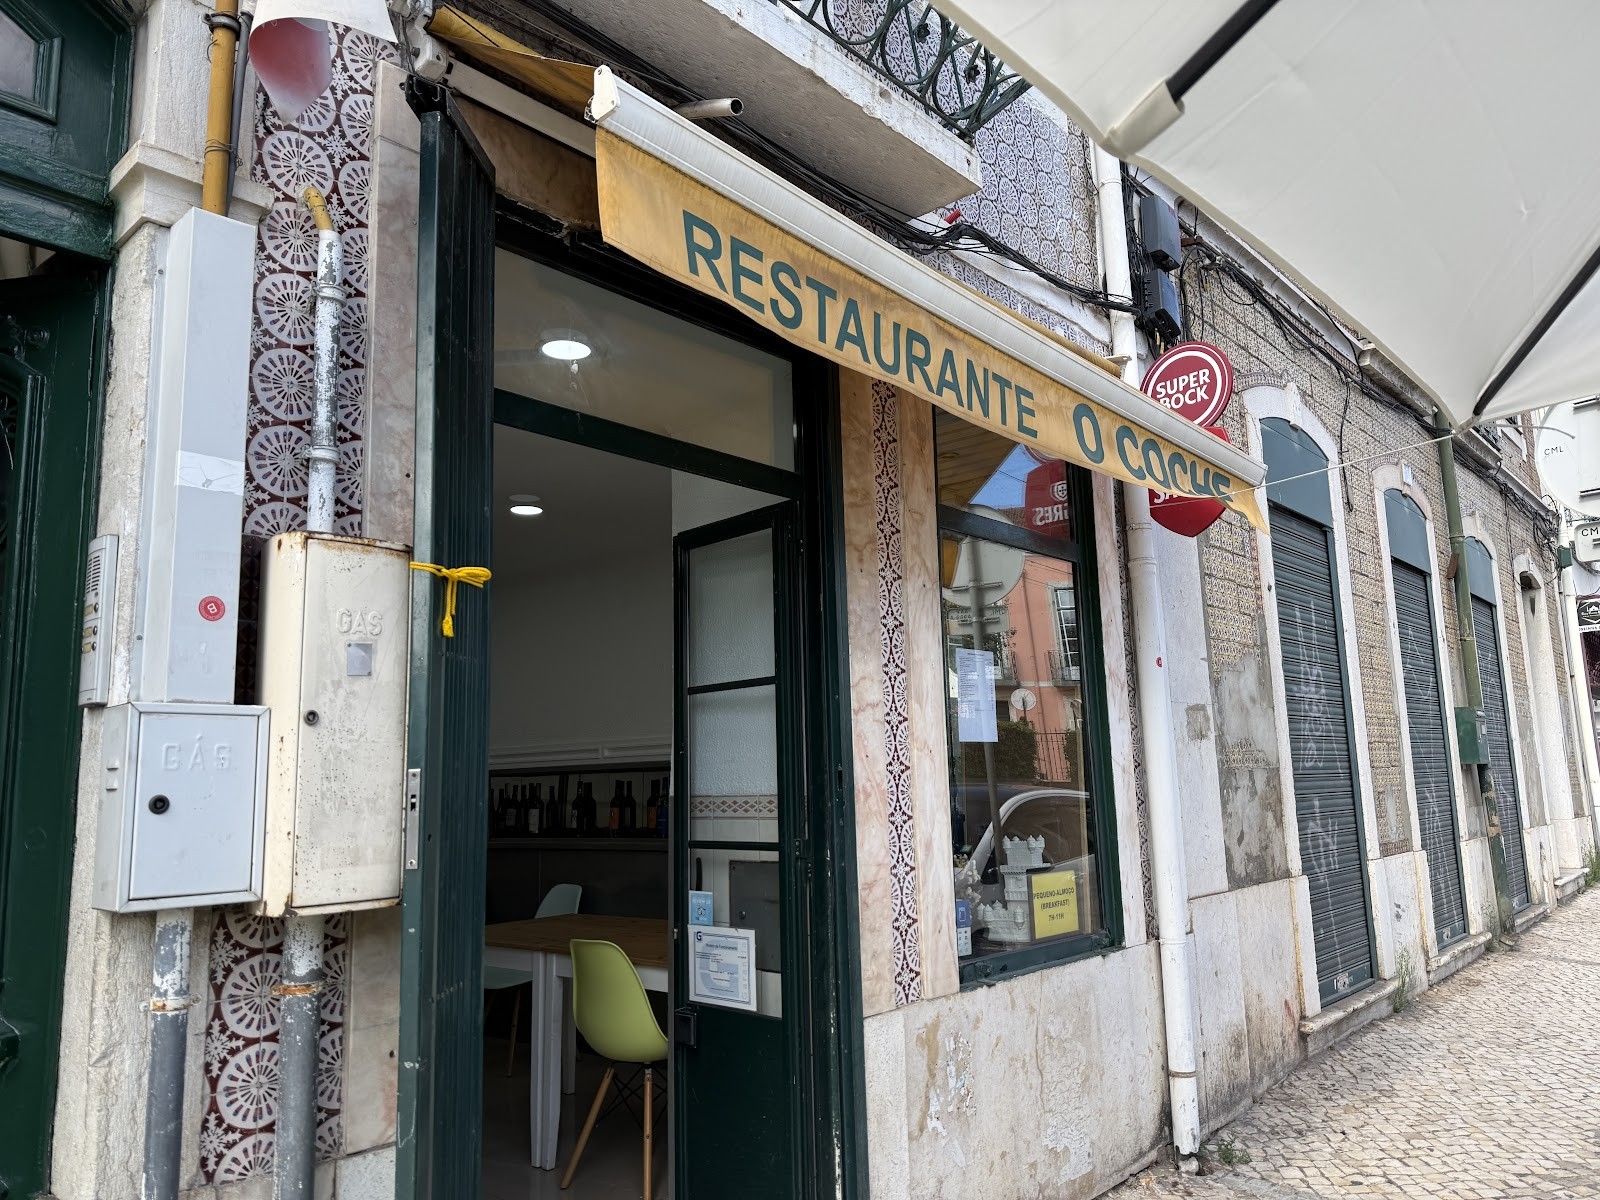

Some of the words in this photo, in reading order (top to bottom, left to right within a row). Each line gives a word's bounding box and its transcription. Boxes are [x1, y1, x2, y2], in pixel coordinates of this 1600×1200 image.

[682, 208, 1038, 439] RESTAURANTE
[1072, 402, 1104, 464] O
[1115, 424, 1233, 503] COCHE
[1156, 368, 1211, 398] SUPER
[1544, 446, 1564, 456] CML
[335, 607, 383, 636] GAS
[162, 734, 232, 771] GÁS
[1033, 887, 1075, 900] PEQUENO-ALMOÇO
[1041, 899, 1070, 911] (BREAKFAST)
